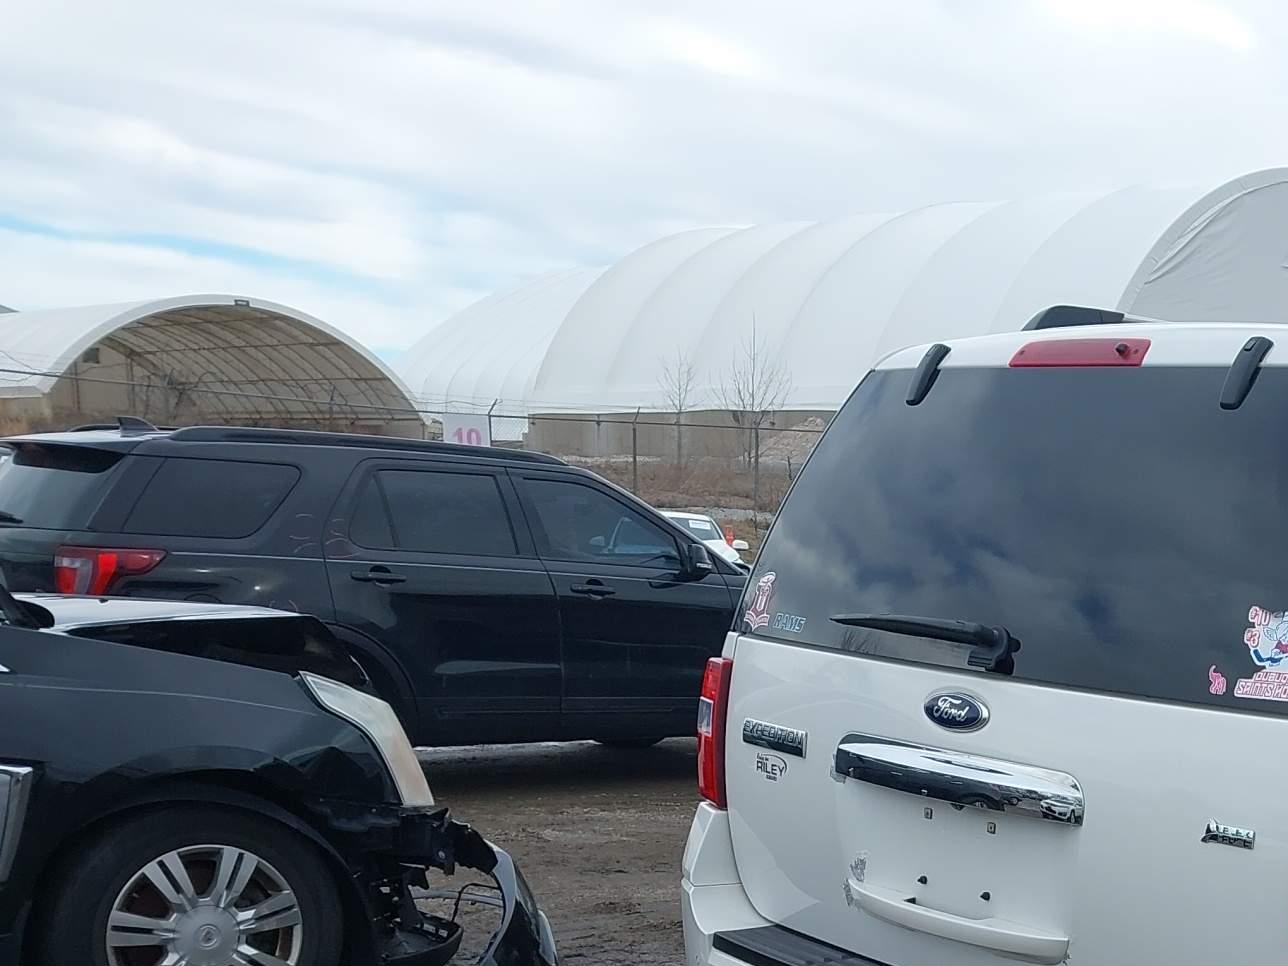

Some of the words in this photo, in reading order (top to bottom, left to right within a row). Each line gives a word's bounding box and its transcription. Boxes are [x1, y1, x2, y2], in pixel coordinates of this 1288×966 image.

[1237, 681, 1274, 698] SAINTS
[933, 696, 970, 721] Ford
[743, 719, 804, 745] EXPEDITION
[756, 760, 785, 777] RILEY
